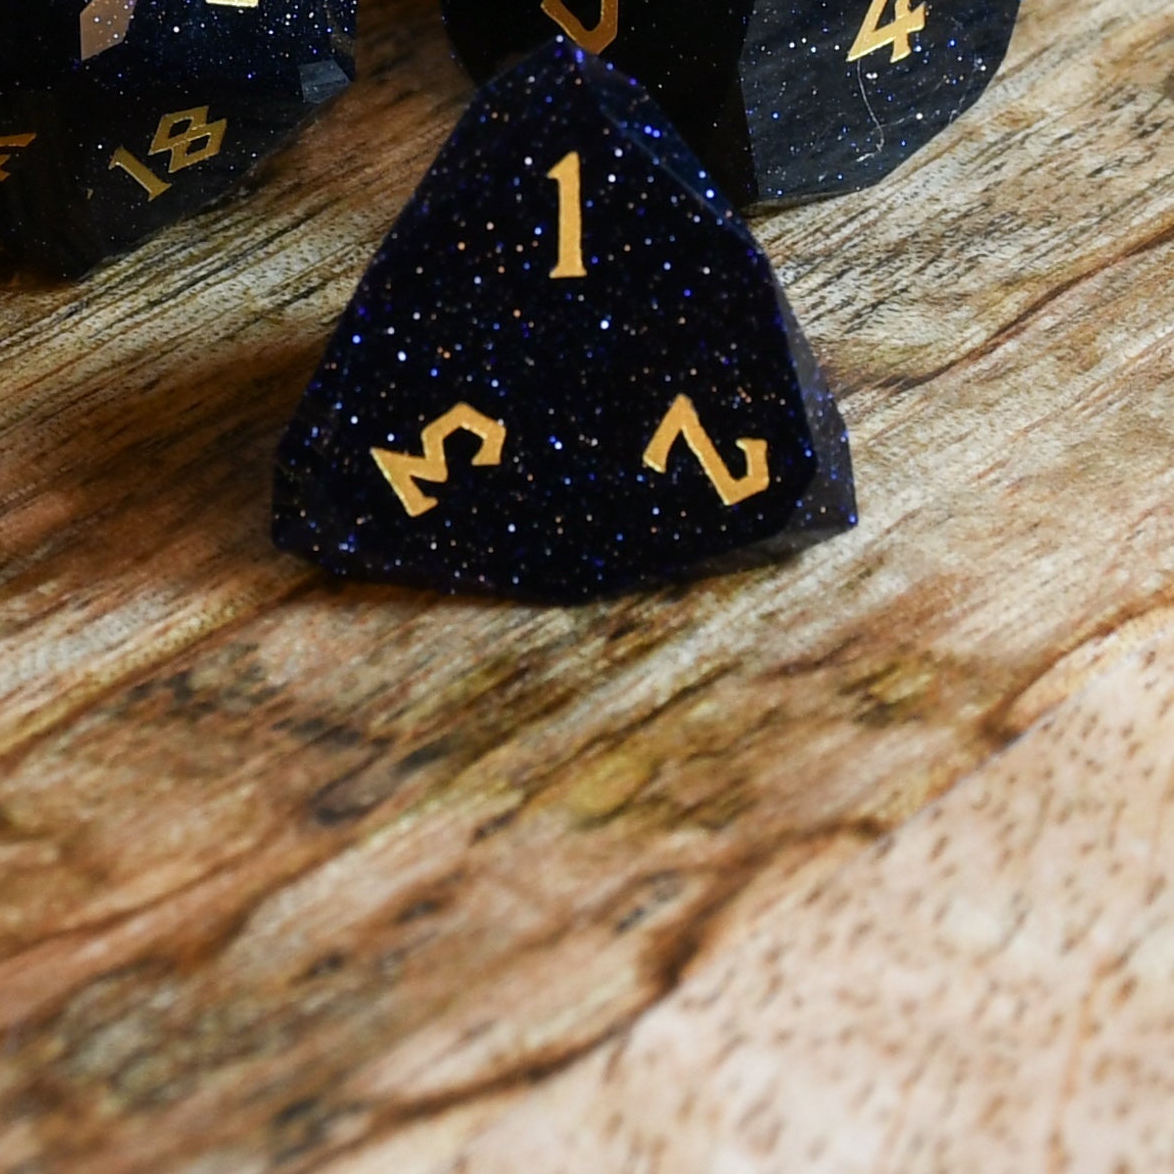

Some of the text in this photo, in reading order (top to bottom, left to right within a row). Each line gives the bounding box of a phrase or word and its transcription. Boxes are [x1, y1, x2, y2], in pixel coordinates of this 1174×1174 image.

[108, 104, 227, 203] 18
[546, 150, 589, 279] 1
[369, 401, 507, 518] 3
[642, 392, 771, 507] 2
